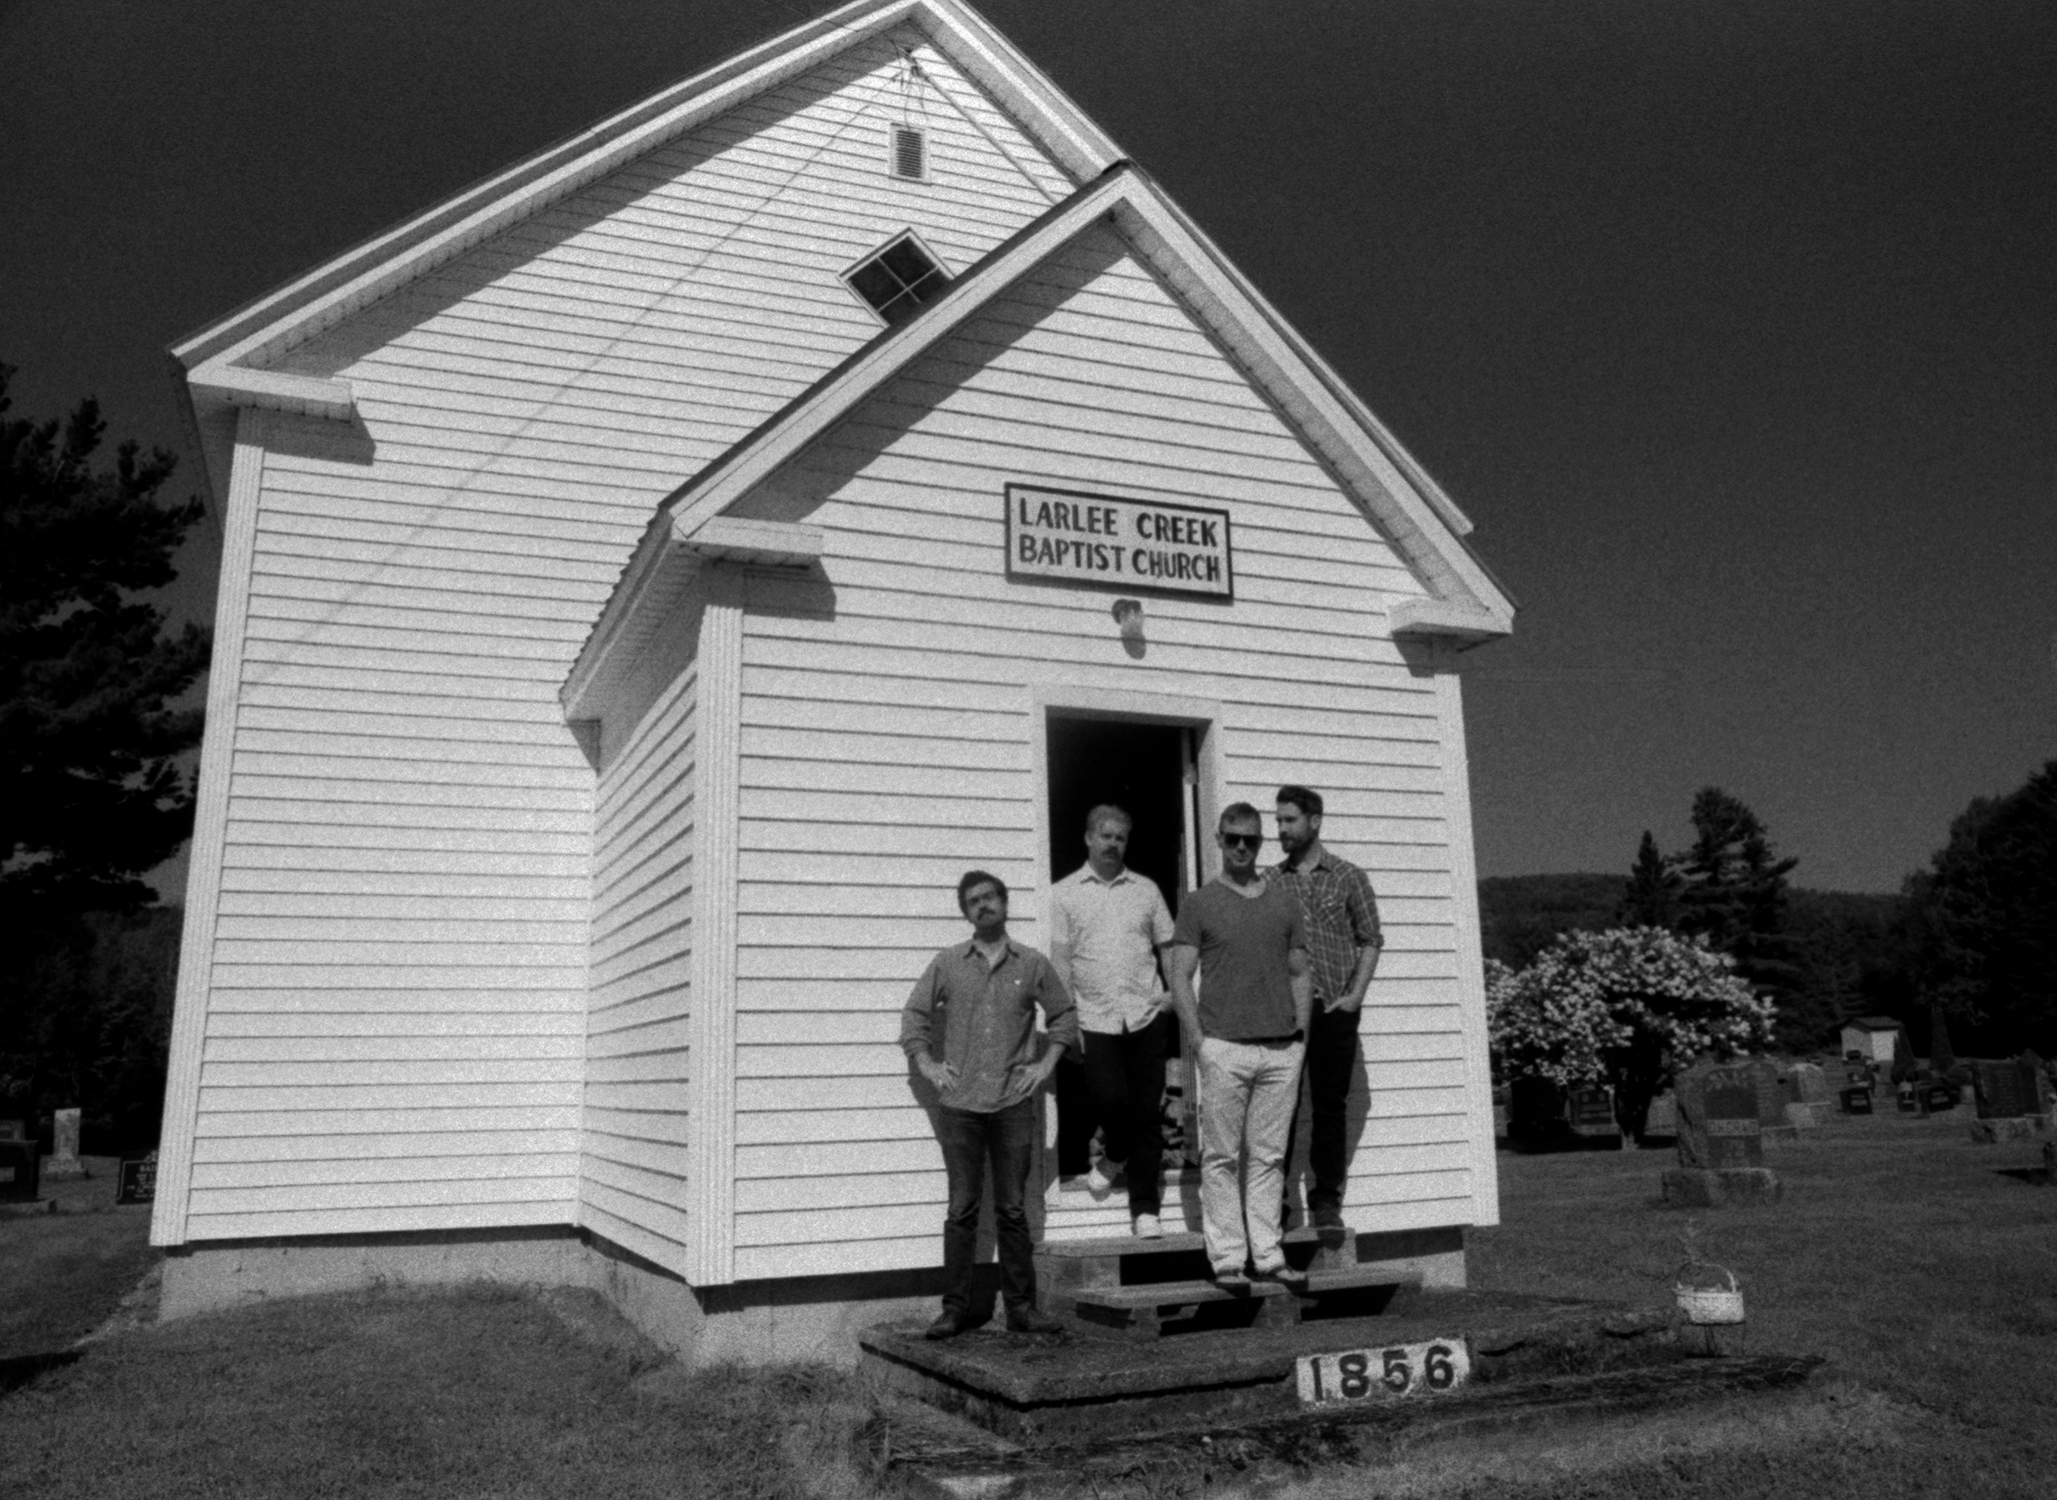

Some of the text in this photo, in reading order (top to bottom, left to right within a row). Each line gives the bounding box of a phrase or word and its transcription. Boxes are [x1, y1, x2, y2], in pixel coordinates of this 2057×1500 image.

[1310, 345, 1455, 402] 1856
[1019, 497, 1218, 548] LARLEE CREEK
[1019, 533, 1221, 583] BAPTIST CHURCH
